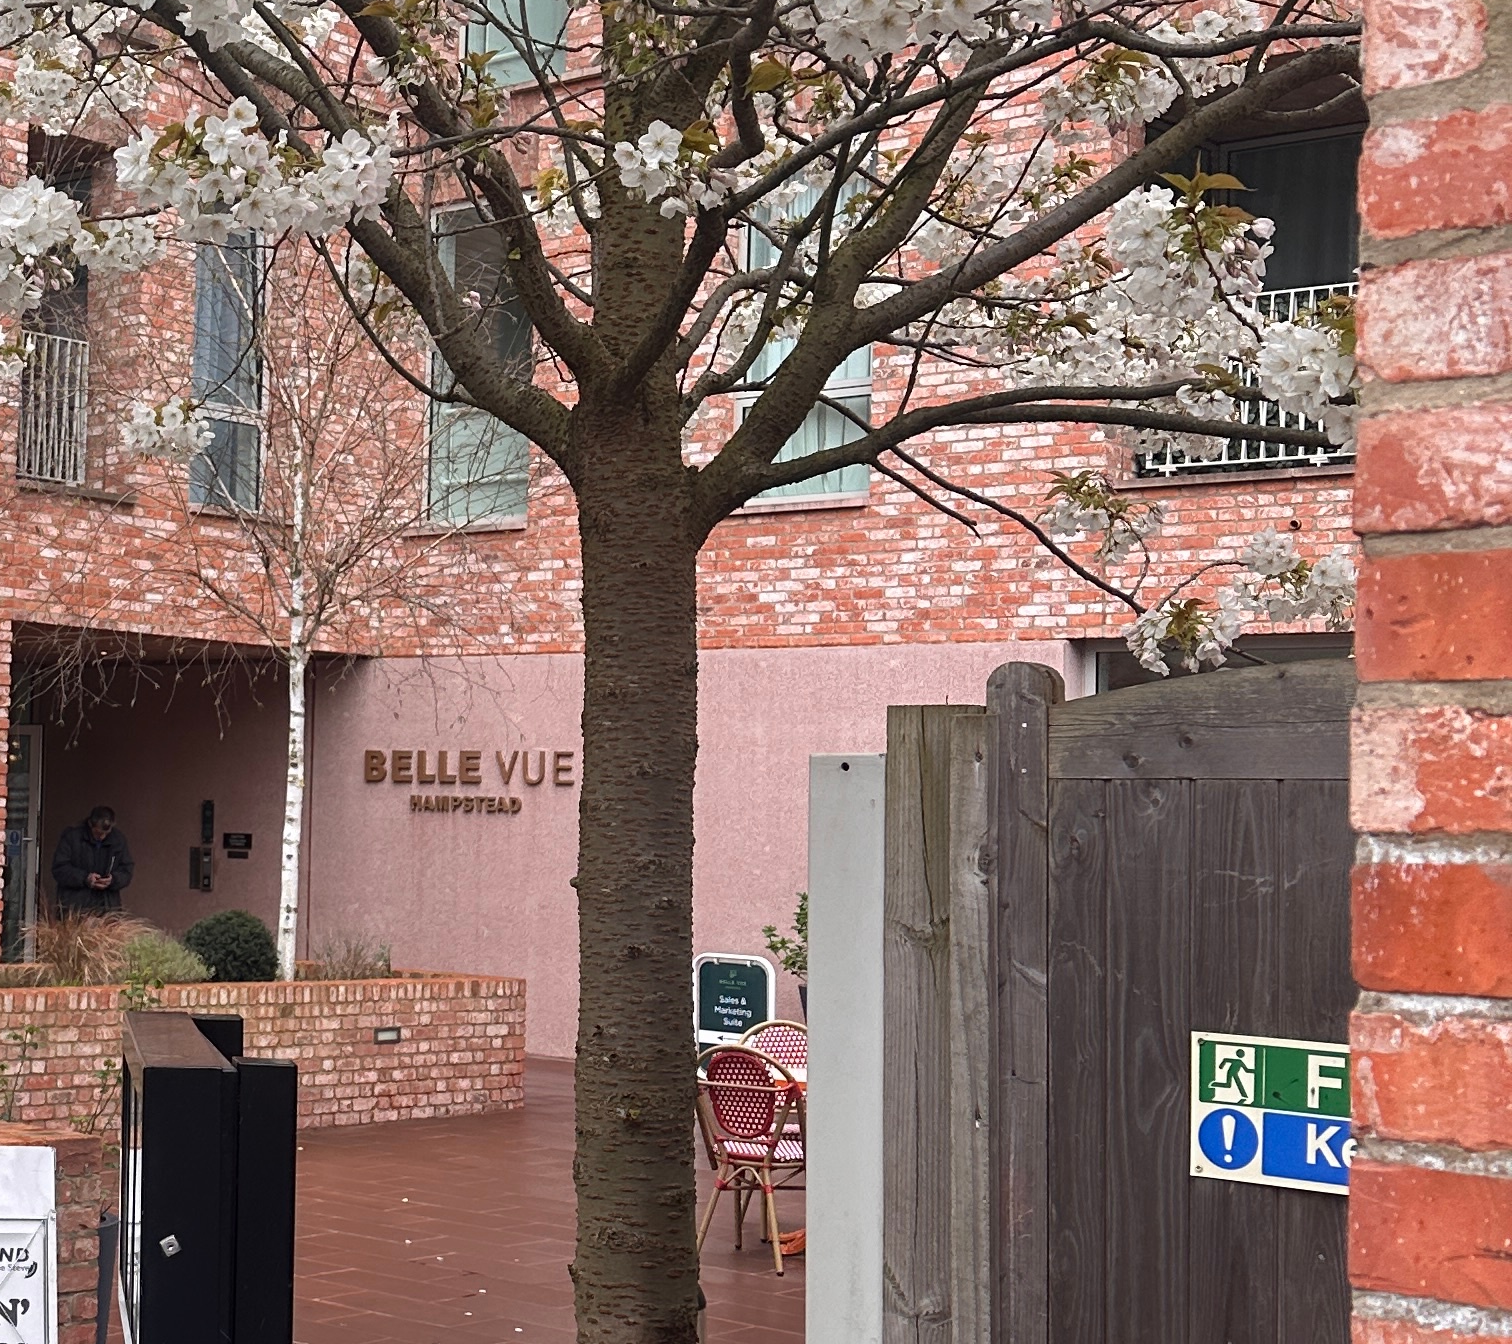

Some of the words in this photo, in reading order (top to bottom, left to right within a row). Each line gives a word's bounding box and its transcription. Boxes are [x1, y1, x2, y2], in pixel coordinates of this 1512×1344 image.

[364, 749, 483, 784] BELLE
[495, 750, 576, 787] VUE
[409, 794, 523, 814] HAMPSTEAD
[719, 994, 740, 1005] Sales
[714, 1005, 752, 1019] Marketing
[723, 1016, 743, 1027] Suite
